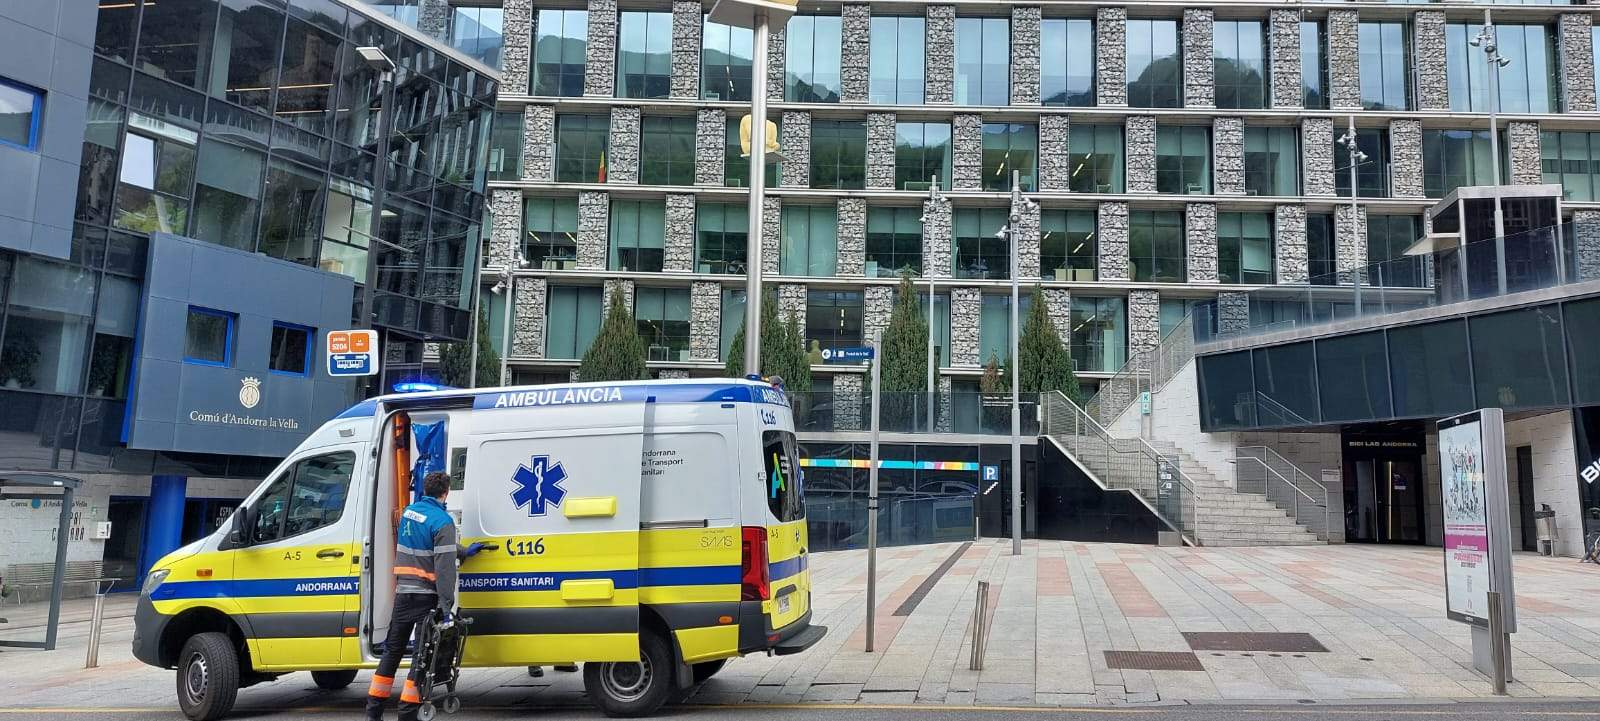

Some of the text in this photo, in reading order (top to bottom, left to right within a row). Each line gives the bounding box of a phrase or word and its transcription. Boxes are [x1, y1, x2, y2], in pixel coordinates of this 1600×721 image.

[189, 410, 299, 429] Comú d'Andorra la Vella
[642, 449, 676, 457] ndorrana
[648, 458, 684, 468] Transport
[641, 468, 665, 476] anitari
[986, 466, 996, 480] P
[1580, 457, 1600, 484] BI
[517, 537, 545, 556] 116
[283, 551, 302, 561] A-5
[510, 576, 554, 587] SANITARI
[295, 582, 353, 592] ANDORRANA
